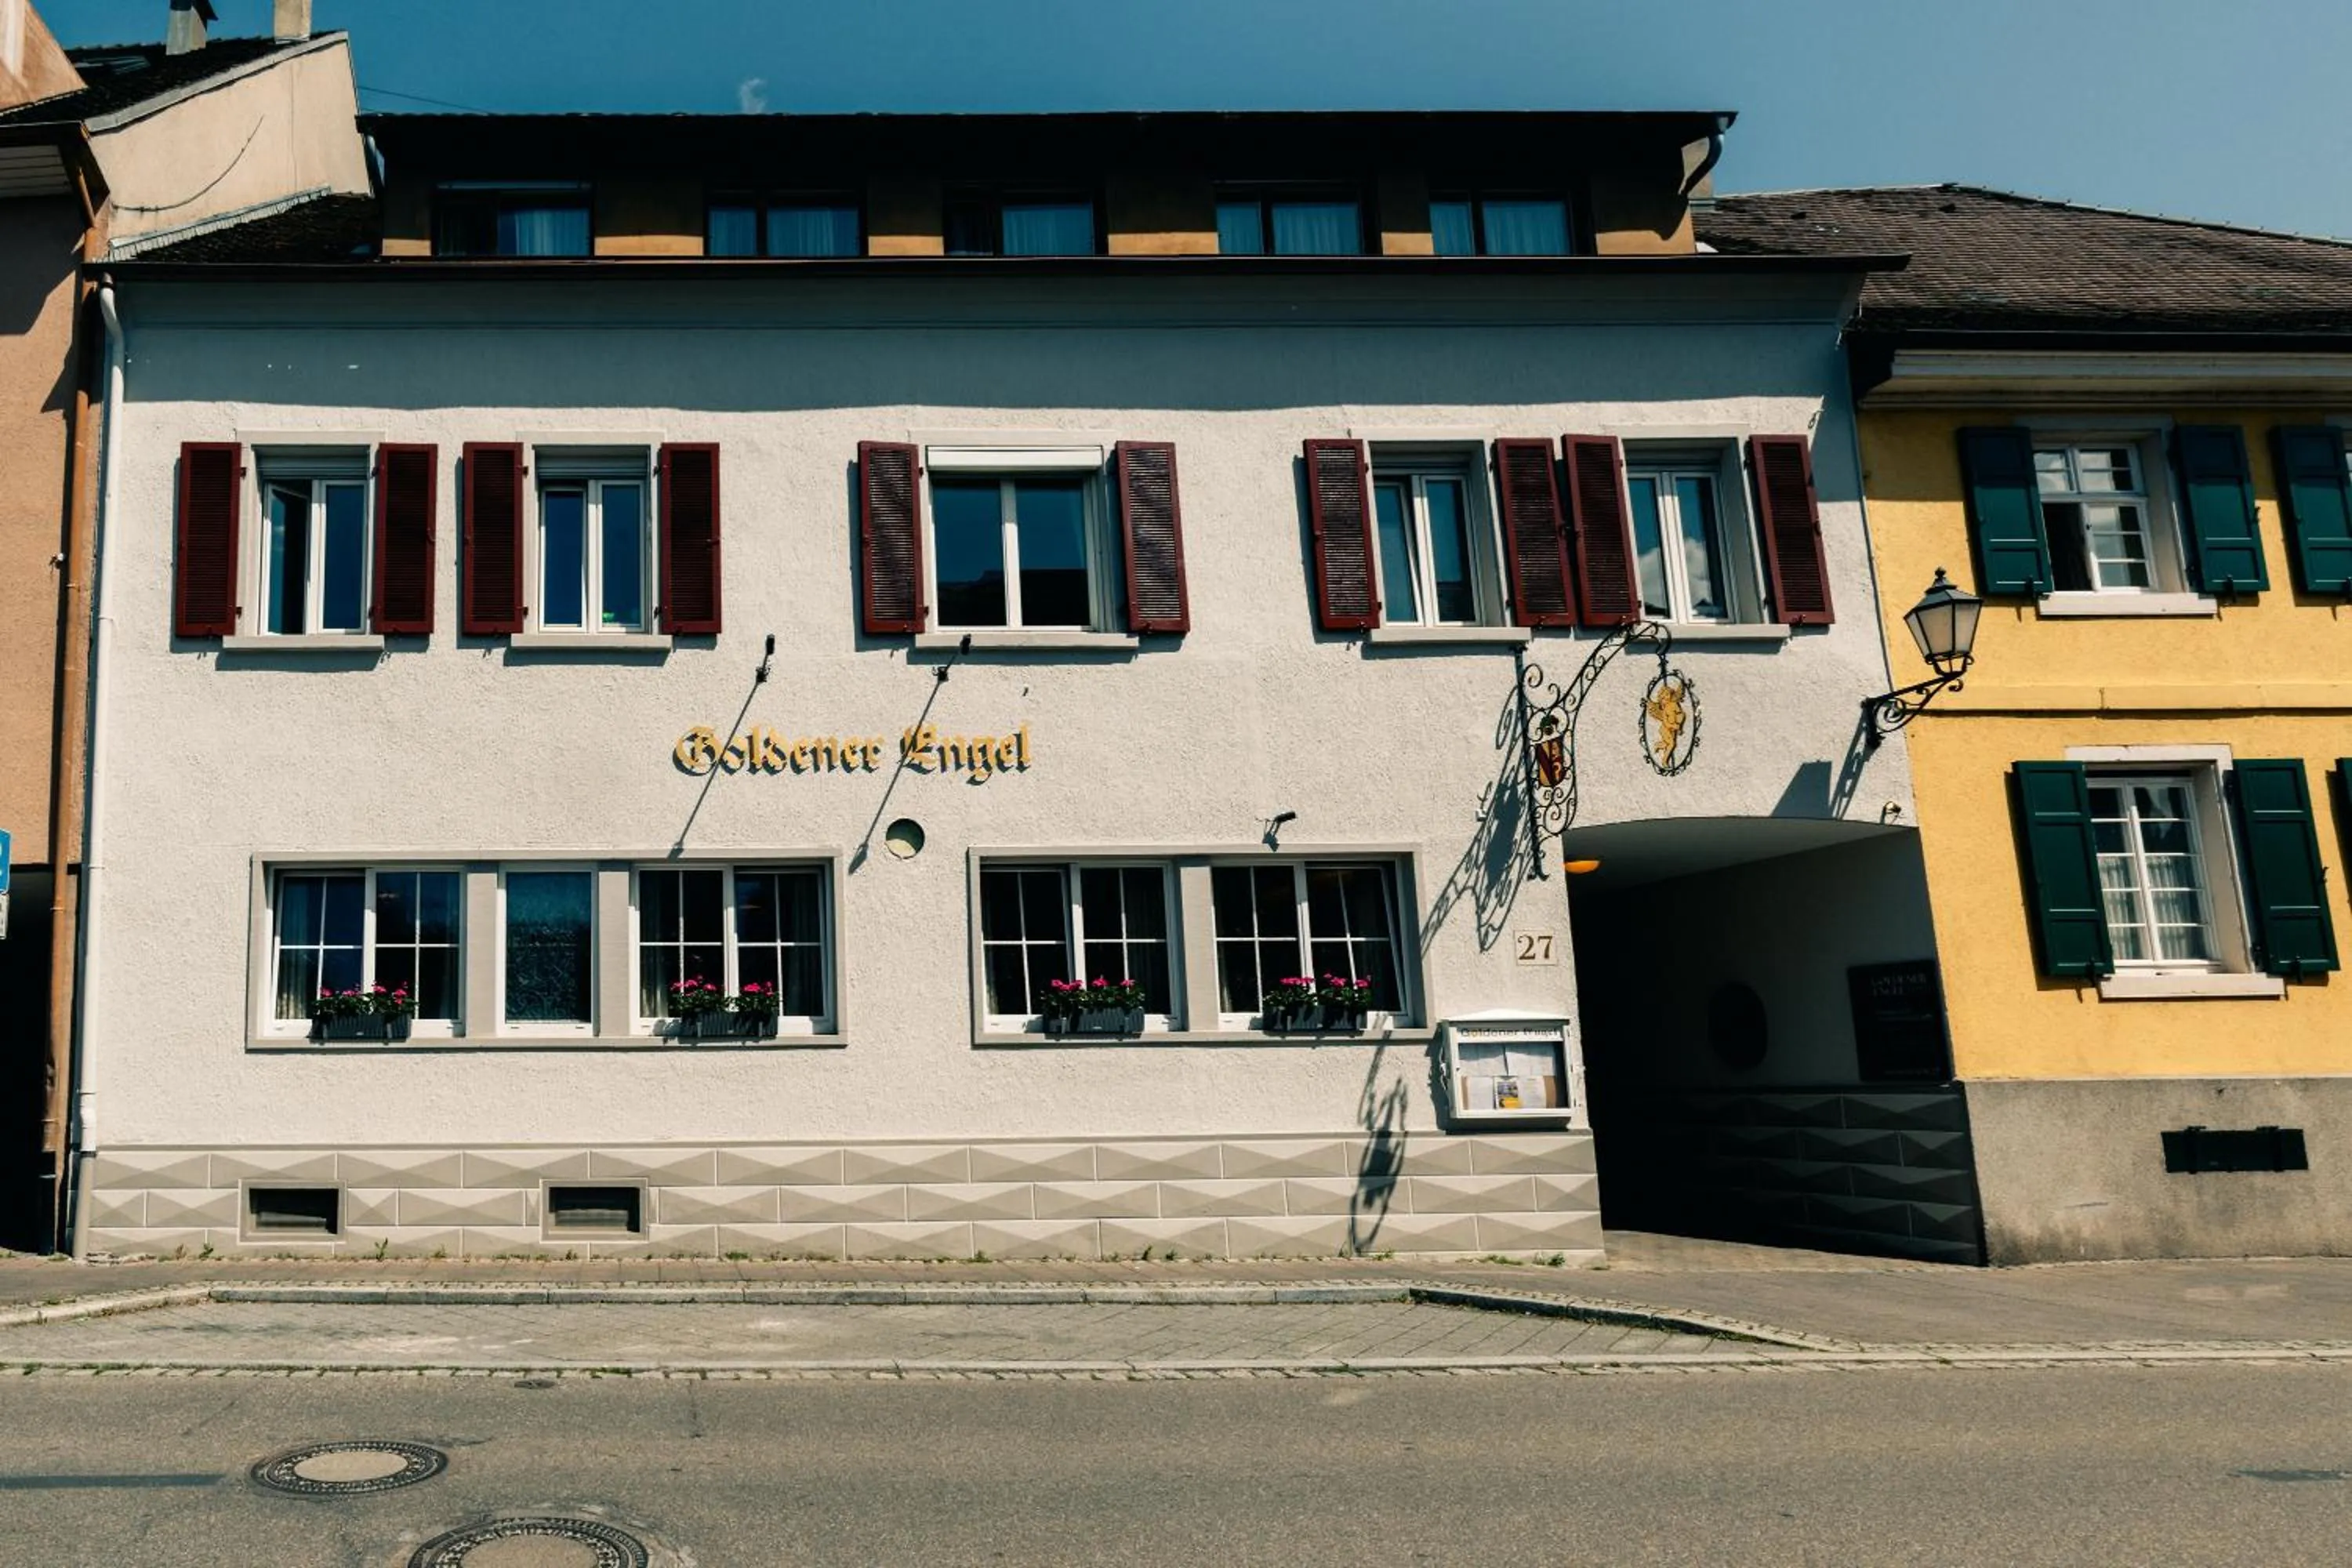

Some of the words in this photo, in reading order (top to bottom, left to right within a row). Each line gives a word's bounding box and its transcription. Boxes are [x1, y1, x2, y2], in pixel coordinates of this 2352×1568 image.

[672, 724, 884, 776] Goldener
[898, 719, 1033, 786] Engel
[1517, 935, 1553, 960] 27
